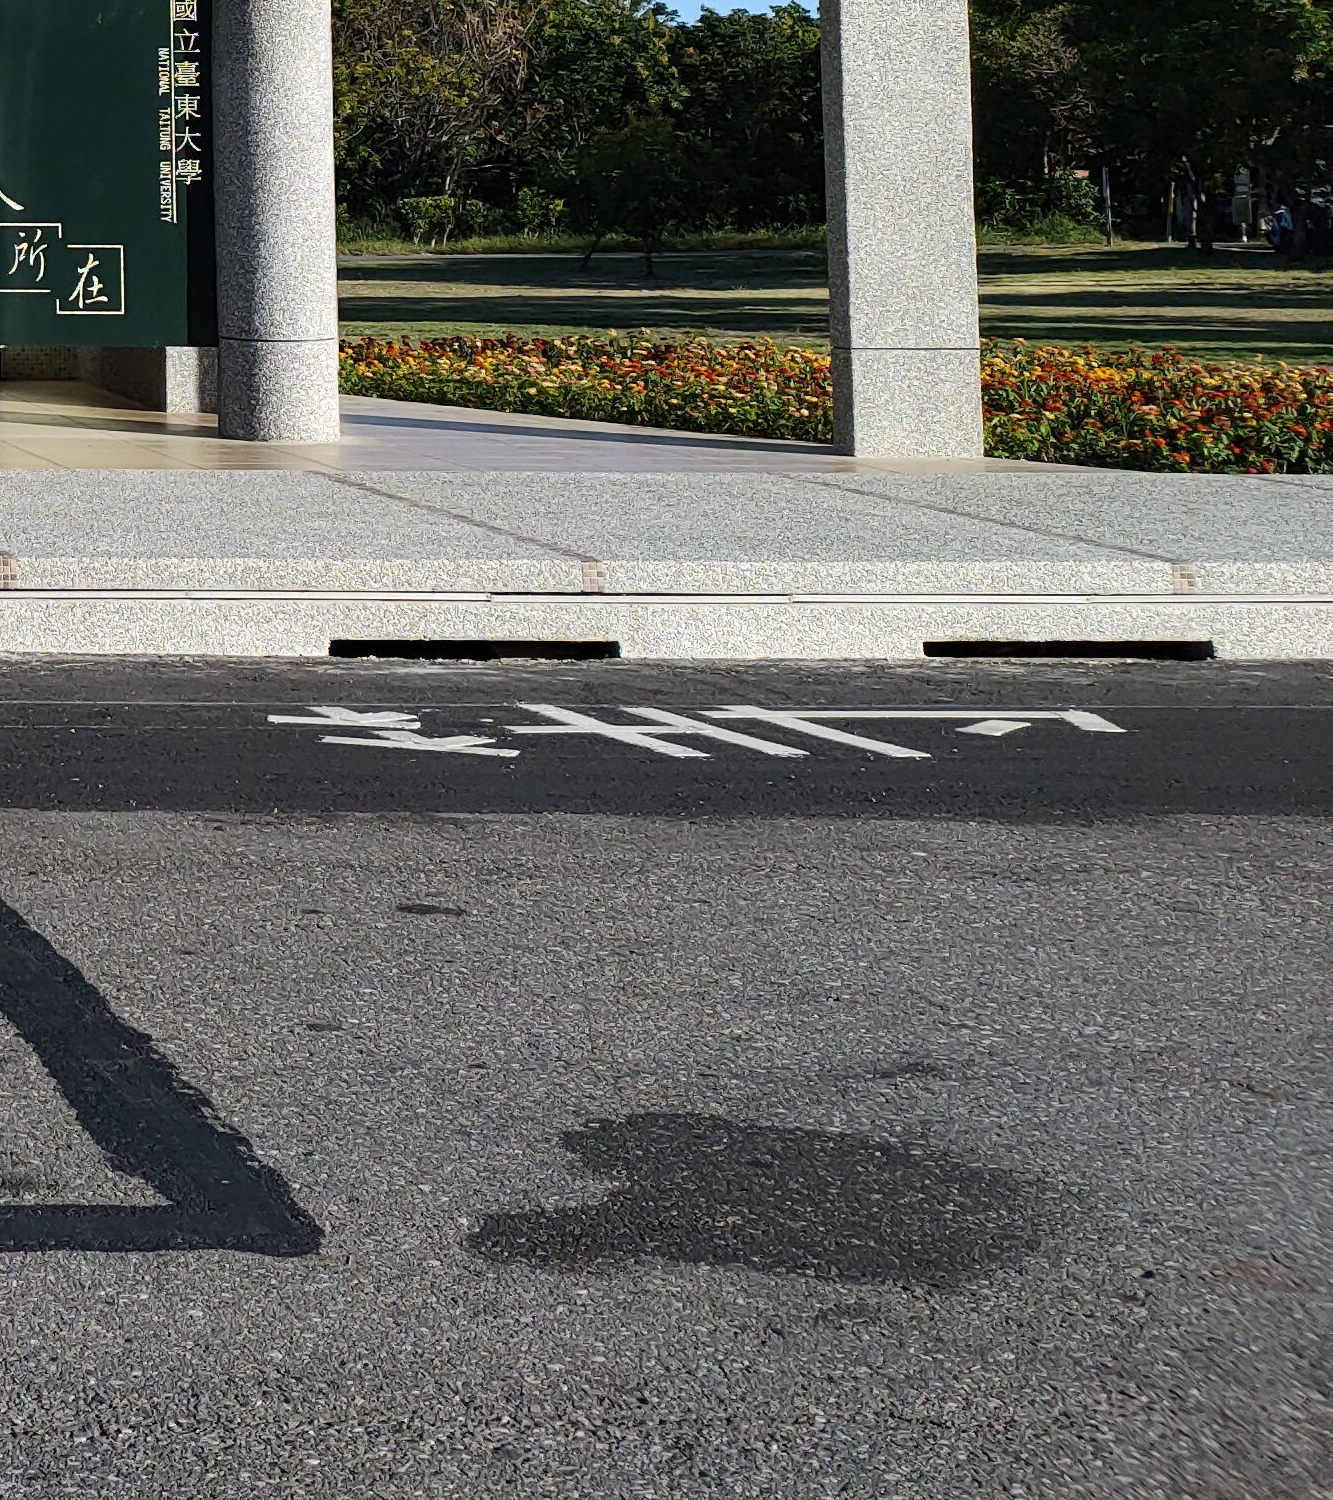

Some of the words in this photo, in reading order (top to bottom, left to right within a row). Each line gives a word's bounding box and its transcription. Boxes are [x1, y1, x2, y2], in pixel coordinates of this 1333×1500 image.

[158, 47, 171, 96] NATIONAL
[158, 107, 171, 151] TAITUNG
[159, 161, 173, 222] UNIVERSITY
